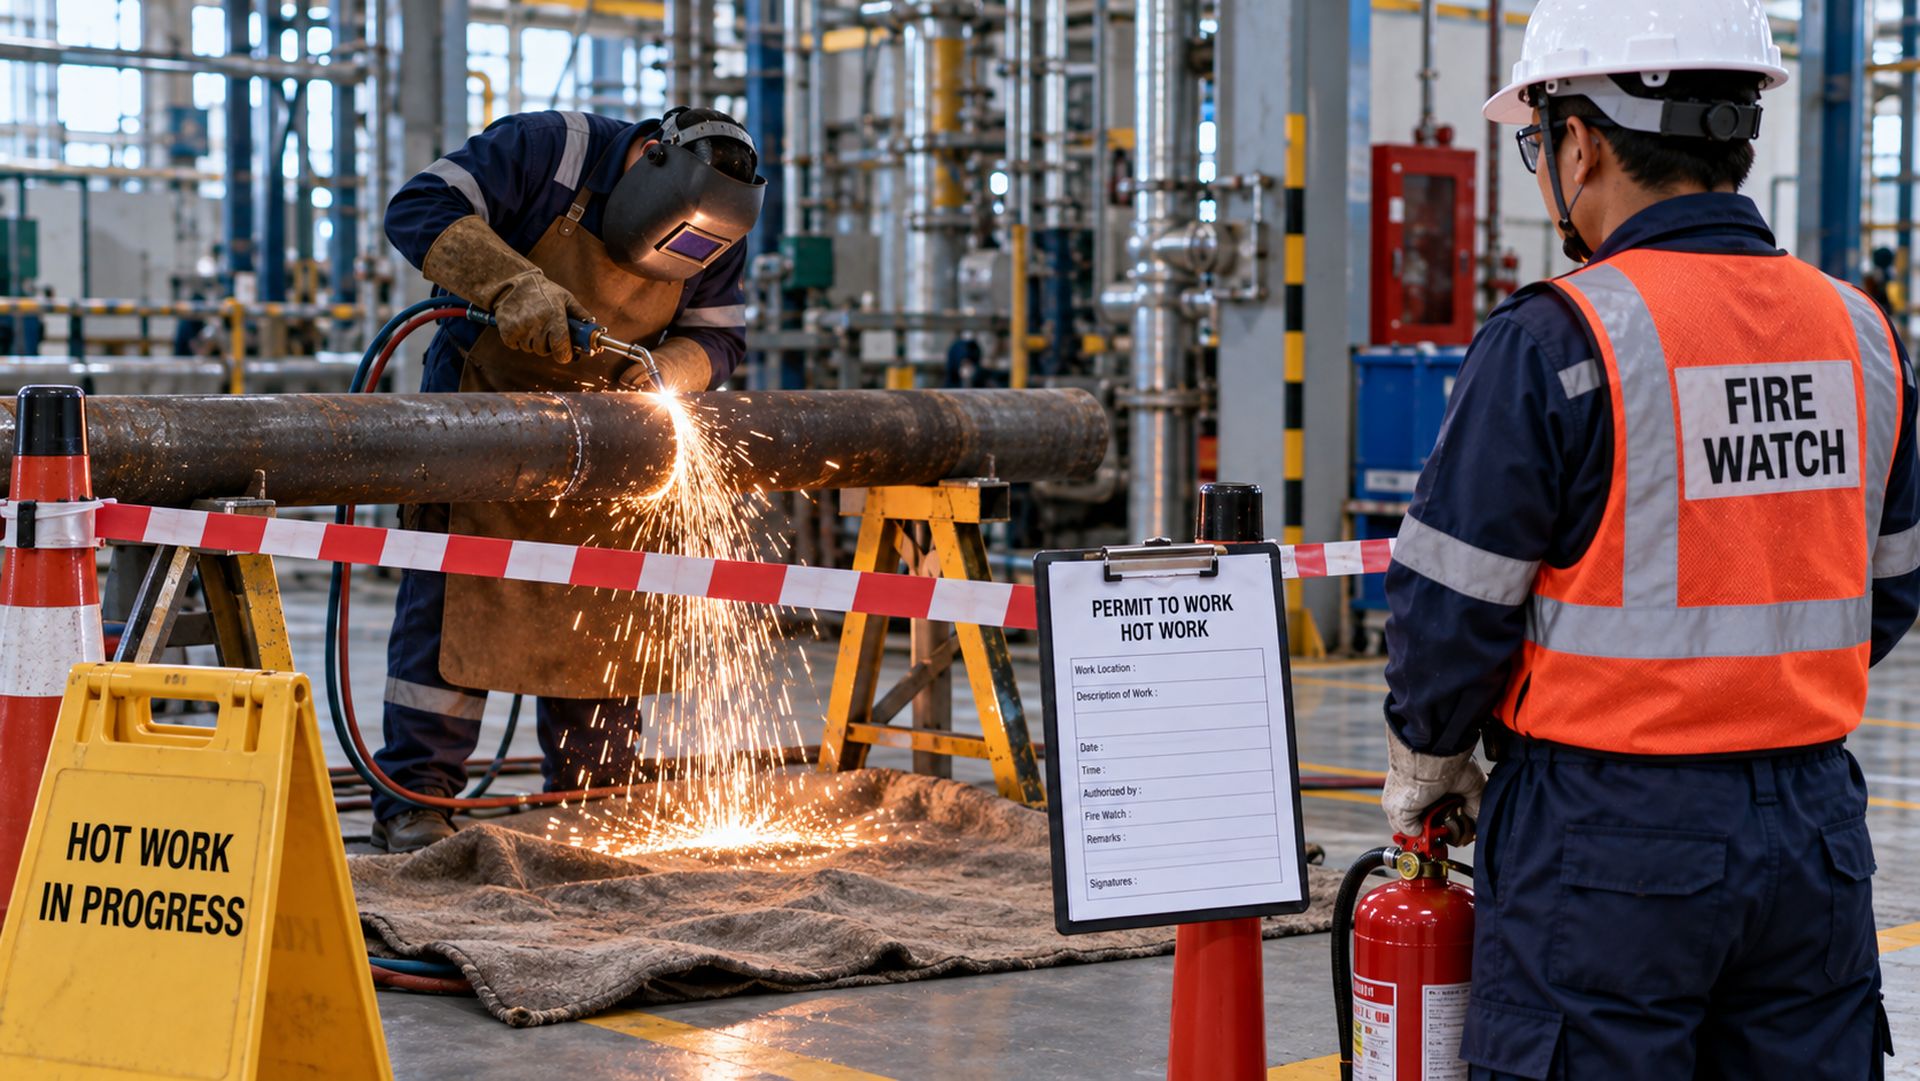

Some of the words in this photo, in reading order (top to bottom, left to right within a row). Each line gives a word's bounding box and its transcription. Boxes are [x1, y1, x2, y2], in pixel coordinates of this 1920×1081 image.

[1725, 374, 1817, 425] FIRE
[1702, 428, 1846, 485] WATCH
[1091, 597, 1154, 619] PERMIT
[1157, 595, 1180, 615] TO
[1183, 593, 1234, 613] WORK
[1120, 622, 1155, 642] HOT
[1158, 619, 1210, 640] WORK
[1074, 664, 1096, 675] Work
[1097, 663, 1131, 675] Location
[1076, 690, 1122, 703] Description
[1122, 688, 1131, 699] of
[1132, 687, 1154, 699] Work
[1080, 742, 1099, 753] Date
[1081, 765, 1101, 776] Time
[1083, 786, 1126, 799] Authorized
[1126, 785, 1138, 797] by
[1084, 811, 1101, 821] Fire
[1101, 809, 1127, 820] Watch
[1086, 833, 1122, 845] Remarks
[66, 821, 132, 865] HOT
[140, 826, 235, 874] WORK
[1089, 877, 1133, 891] Signatures
[38, 881, 74, 923] IN
[80, 885, 246, 938] PROGRESS
